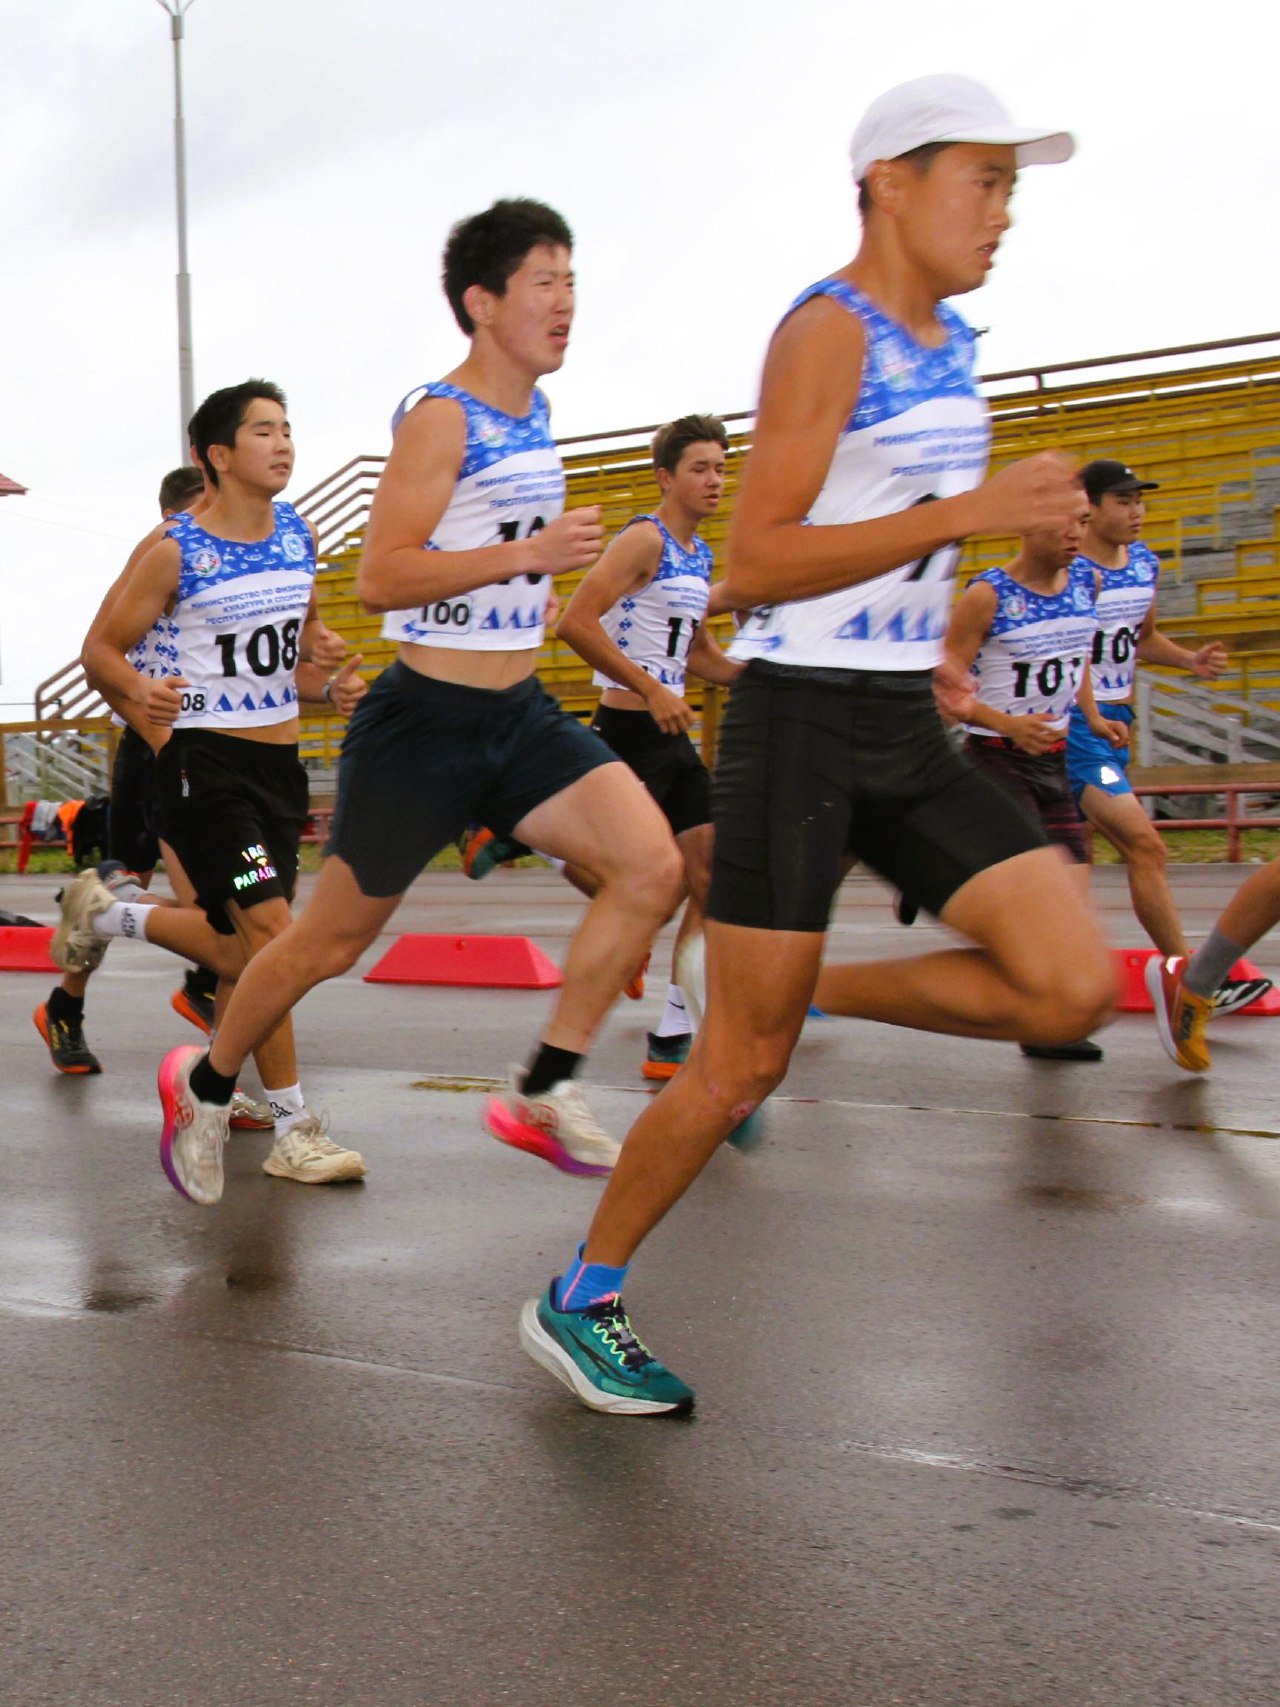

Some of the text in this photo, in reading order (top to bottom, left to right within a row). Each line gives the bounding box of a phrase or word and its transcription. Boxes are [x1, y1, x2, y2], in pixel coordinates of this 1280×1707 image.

[421, 601, 470, 626] 100
[215, 618, 301, 677] 108
[213, 685, 298, 711] АЛДА
